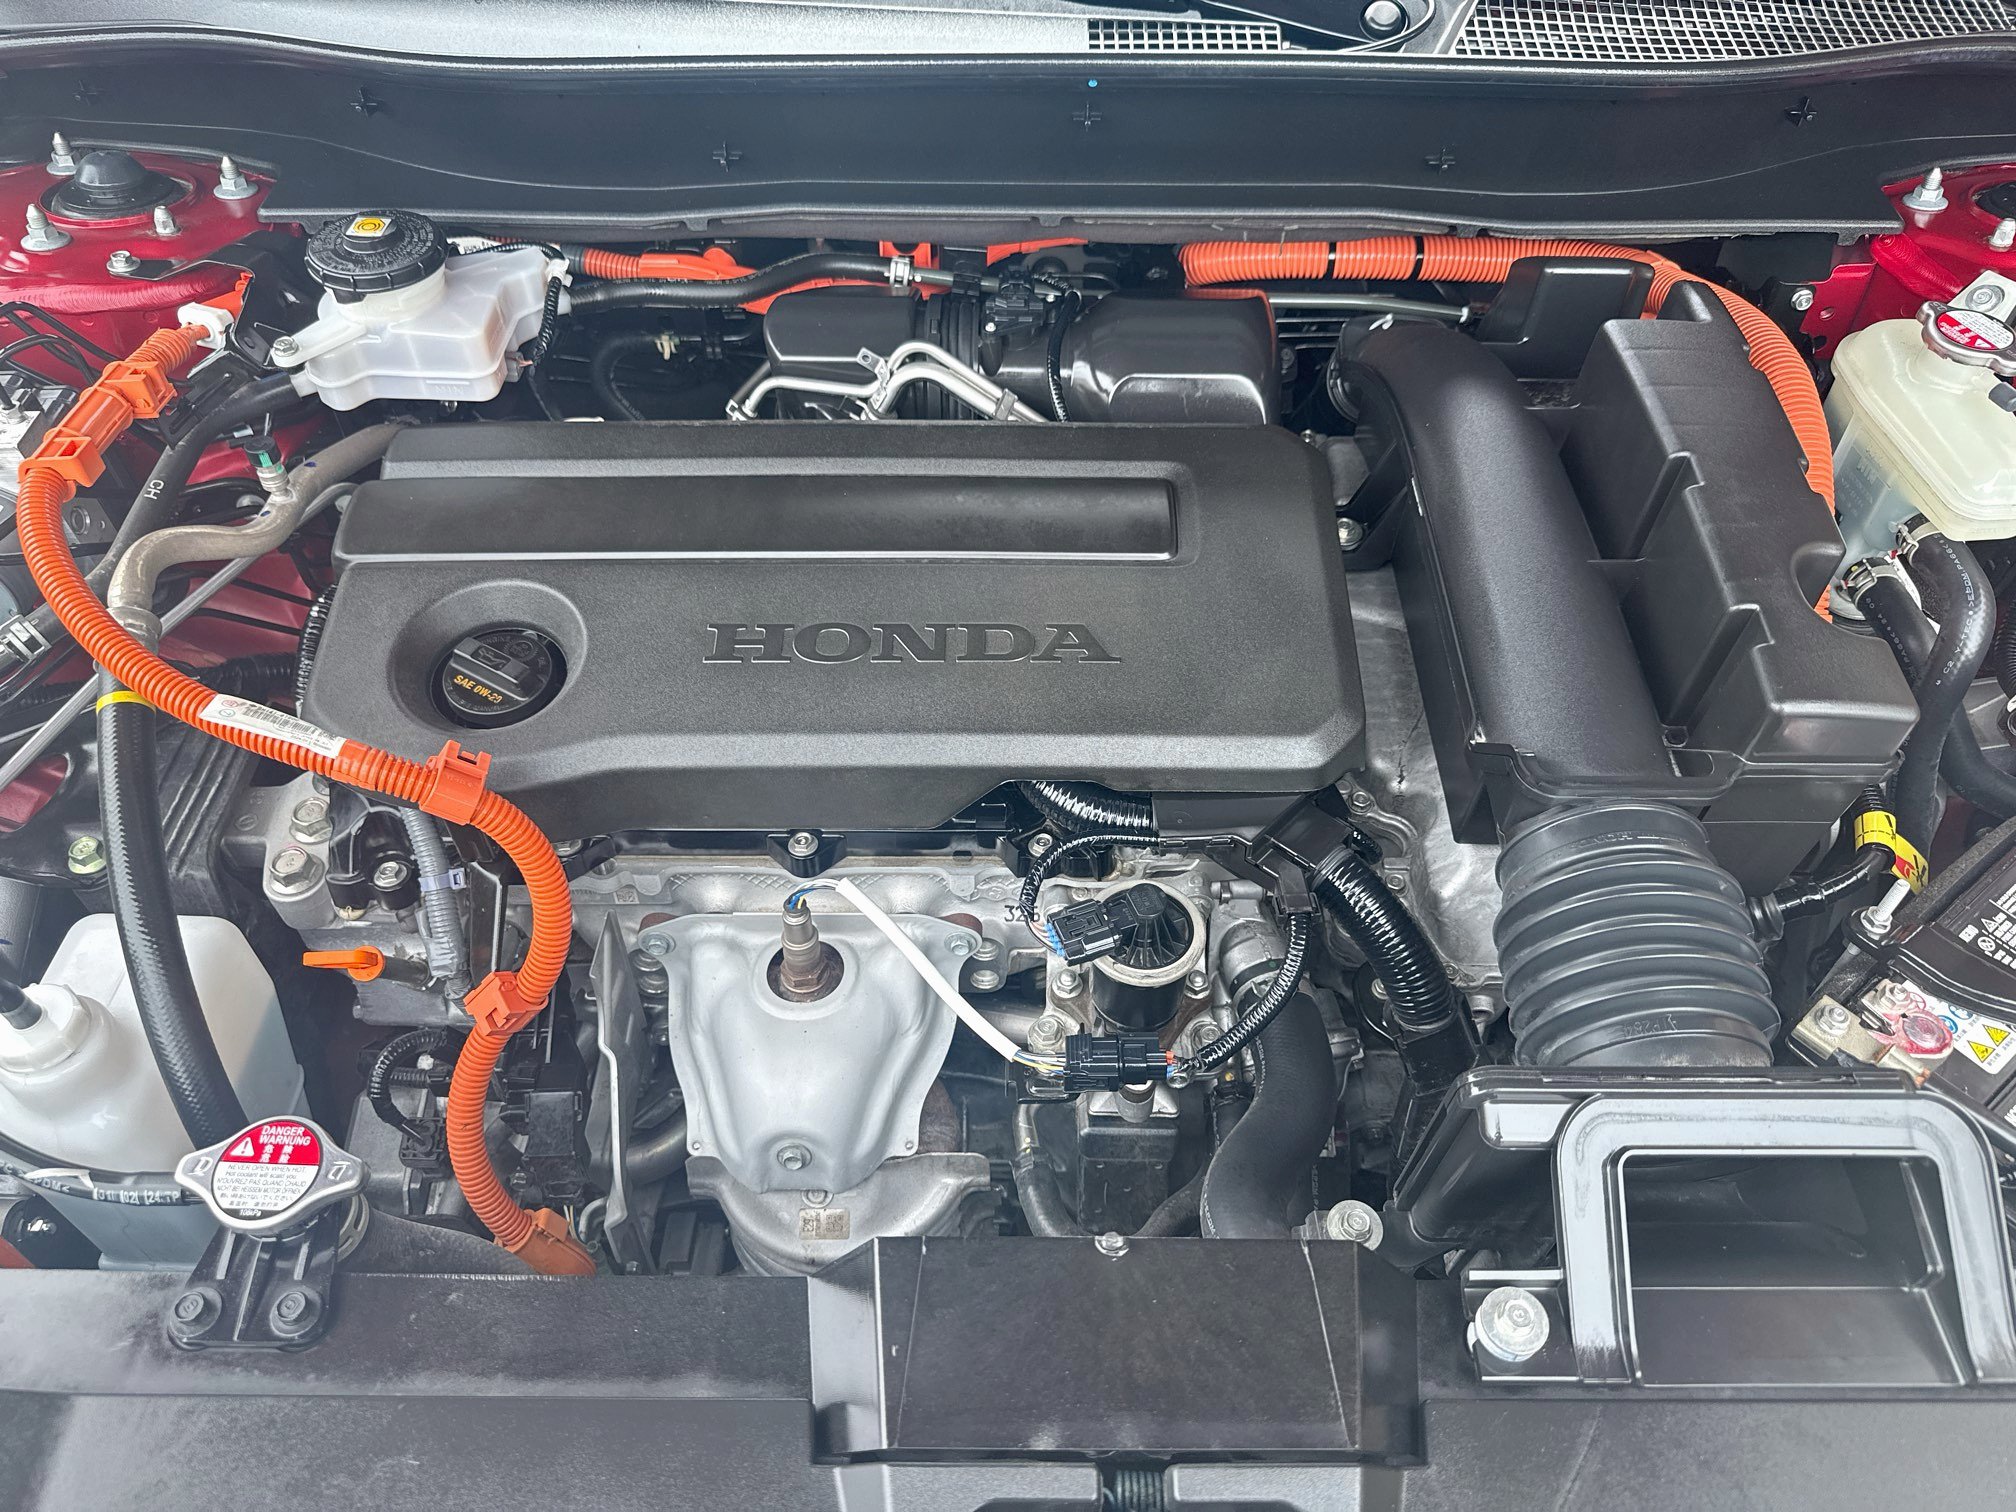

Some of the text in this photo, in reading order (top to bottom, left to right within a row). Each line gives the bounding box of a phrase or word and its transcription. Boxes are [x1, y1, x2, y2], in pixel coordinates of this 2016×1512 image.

[144, 480, 164, 499] CH
[702, 622, 1121, 664] HONDA
[453, 675, 503, 704] SAE 0W-20
[259, 1134, 311, 1146] WARNUNG
[261, 1125, 305, 1136] DANGER
